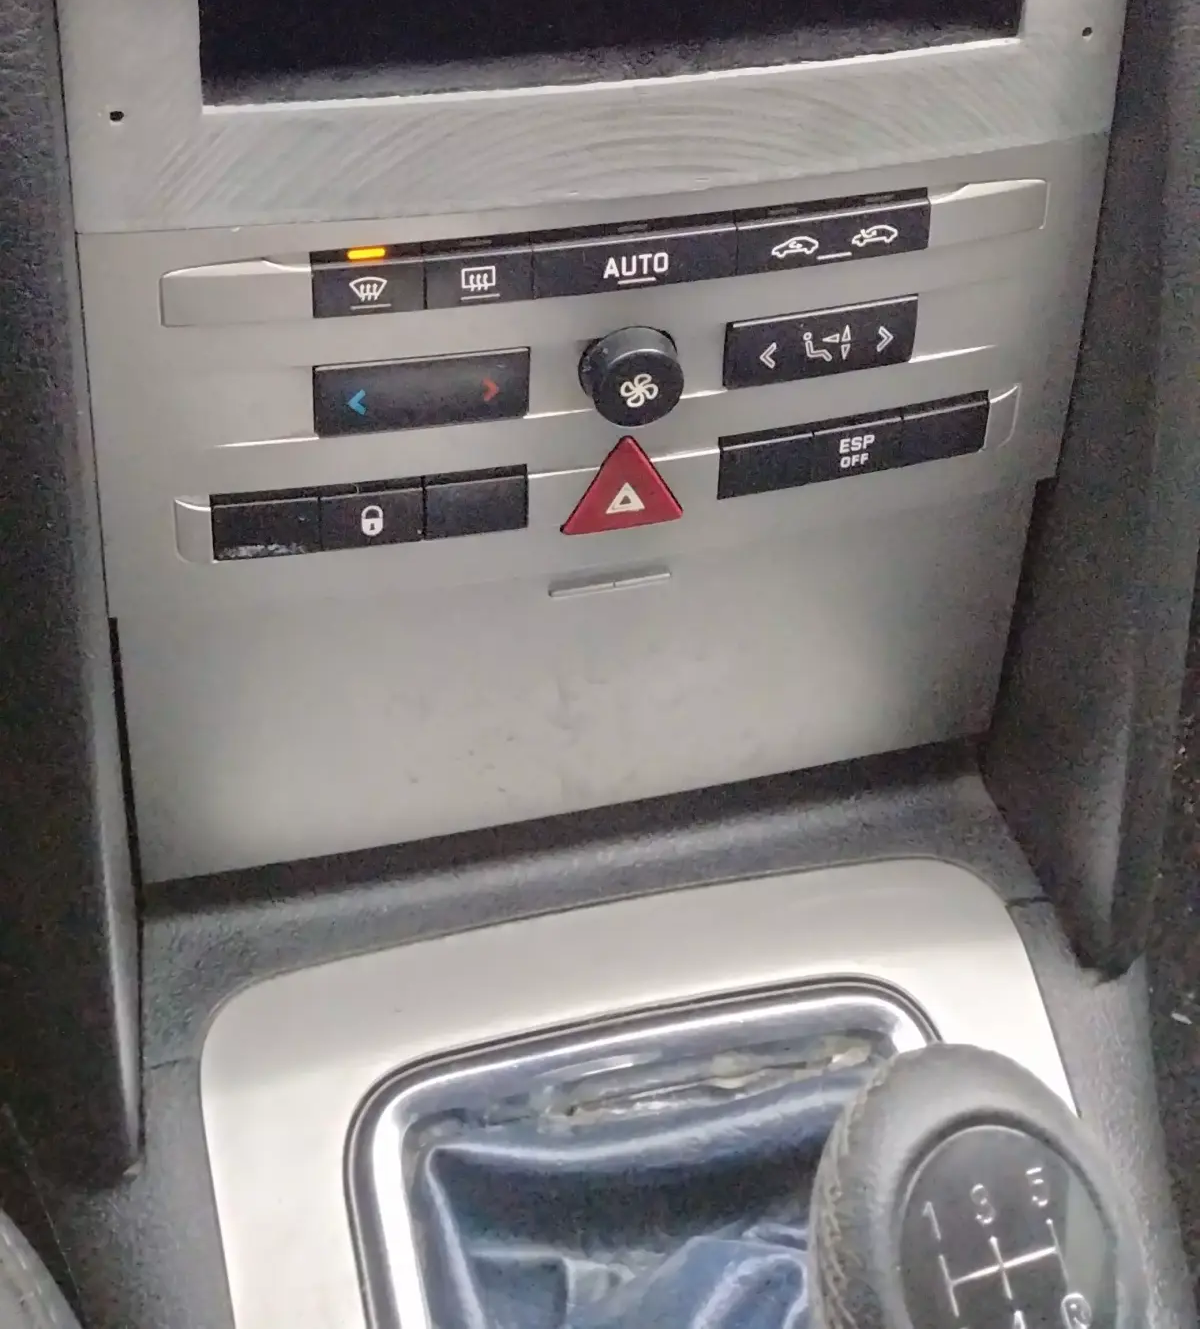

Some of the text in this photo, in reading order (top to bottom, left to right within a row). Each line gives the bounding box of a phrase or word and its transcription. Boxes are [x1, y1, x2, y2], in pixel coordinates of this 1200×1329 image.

[603, 251, 669, 279] AUTO
[838, 433, 876, 455] ESP
[839, 452, 870, 469] OFF
[922, 1201, 942, 1241] 1
[1026, 1166, 1050, 1208] 5
